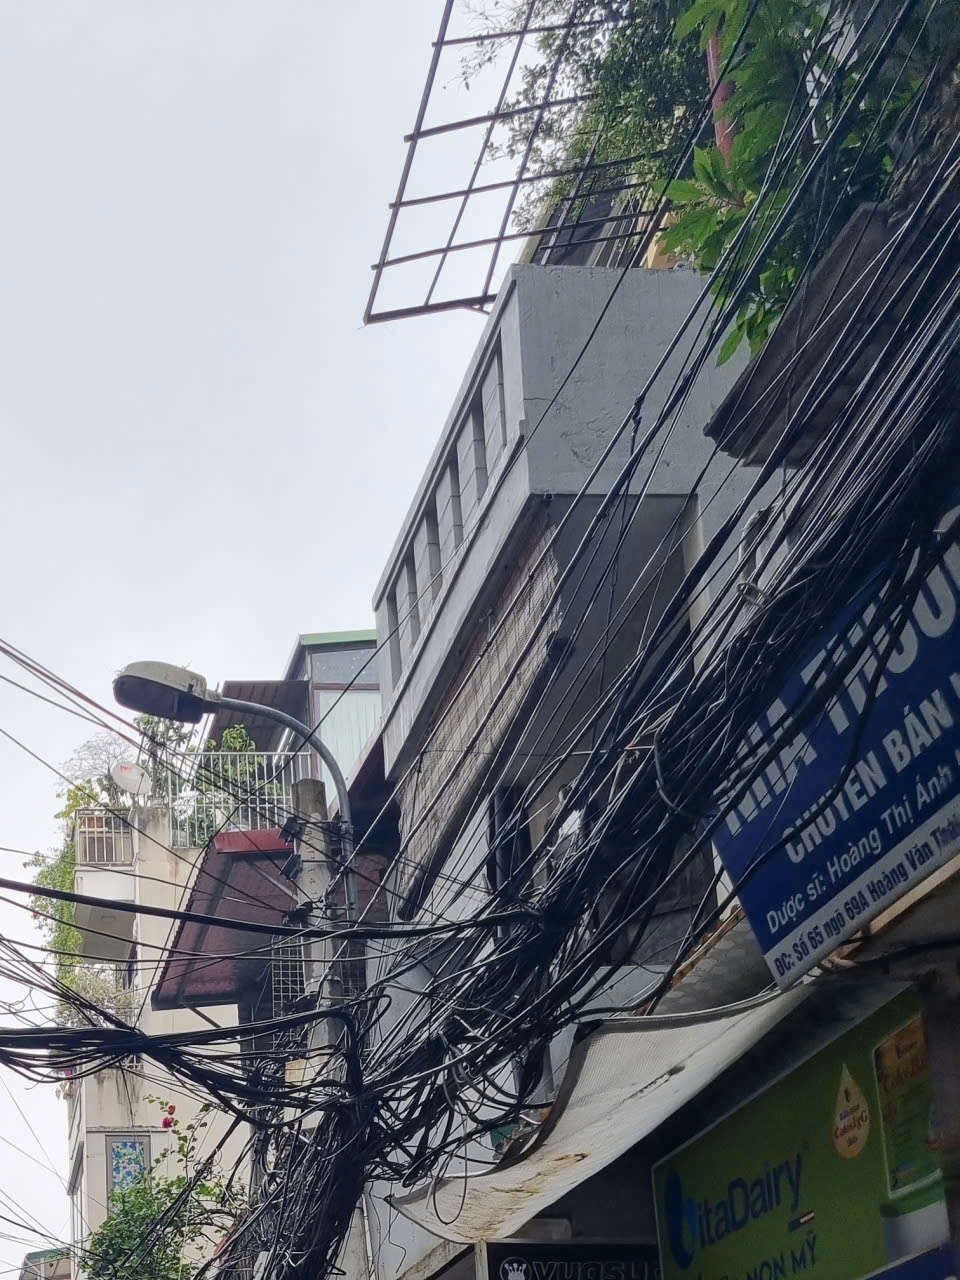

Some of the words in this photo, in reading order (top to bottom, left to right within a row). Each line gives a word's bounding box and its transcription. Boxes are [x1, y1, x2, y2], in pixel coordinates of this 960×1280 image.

[882, 688, 954, 773] BÁN
[766, 892, 805, 934] Dược
[826, 829, 883, 884] Hoàng
[881, 796, 914, 836] Thị
[915, 763, 954, 811] Ánh
[792, 935, 811, 961] Số
[808, 924, 824, 949] 65
[844, 889, 871, 921] 69A
[867, 860, 909, 902] Hoàng
[905, 842, 934, 878] Văn
